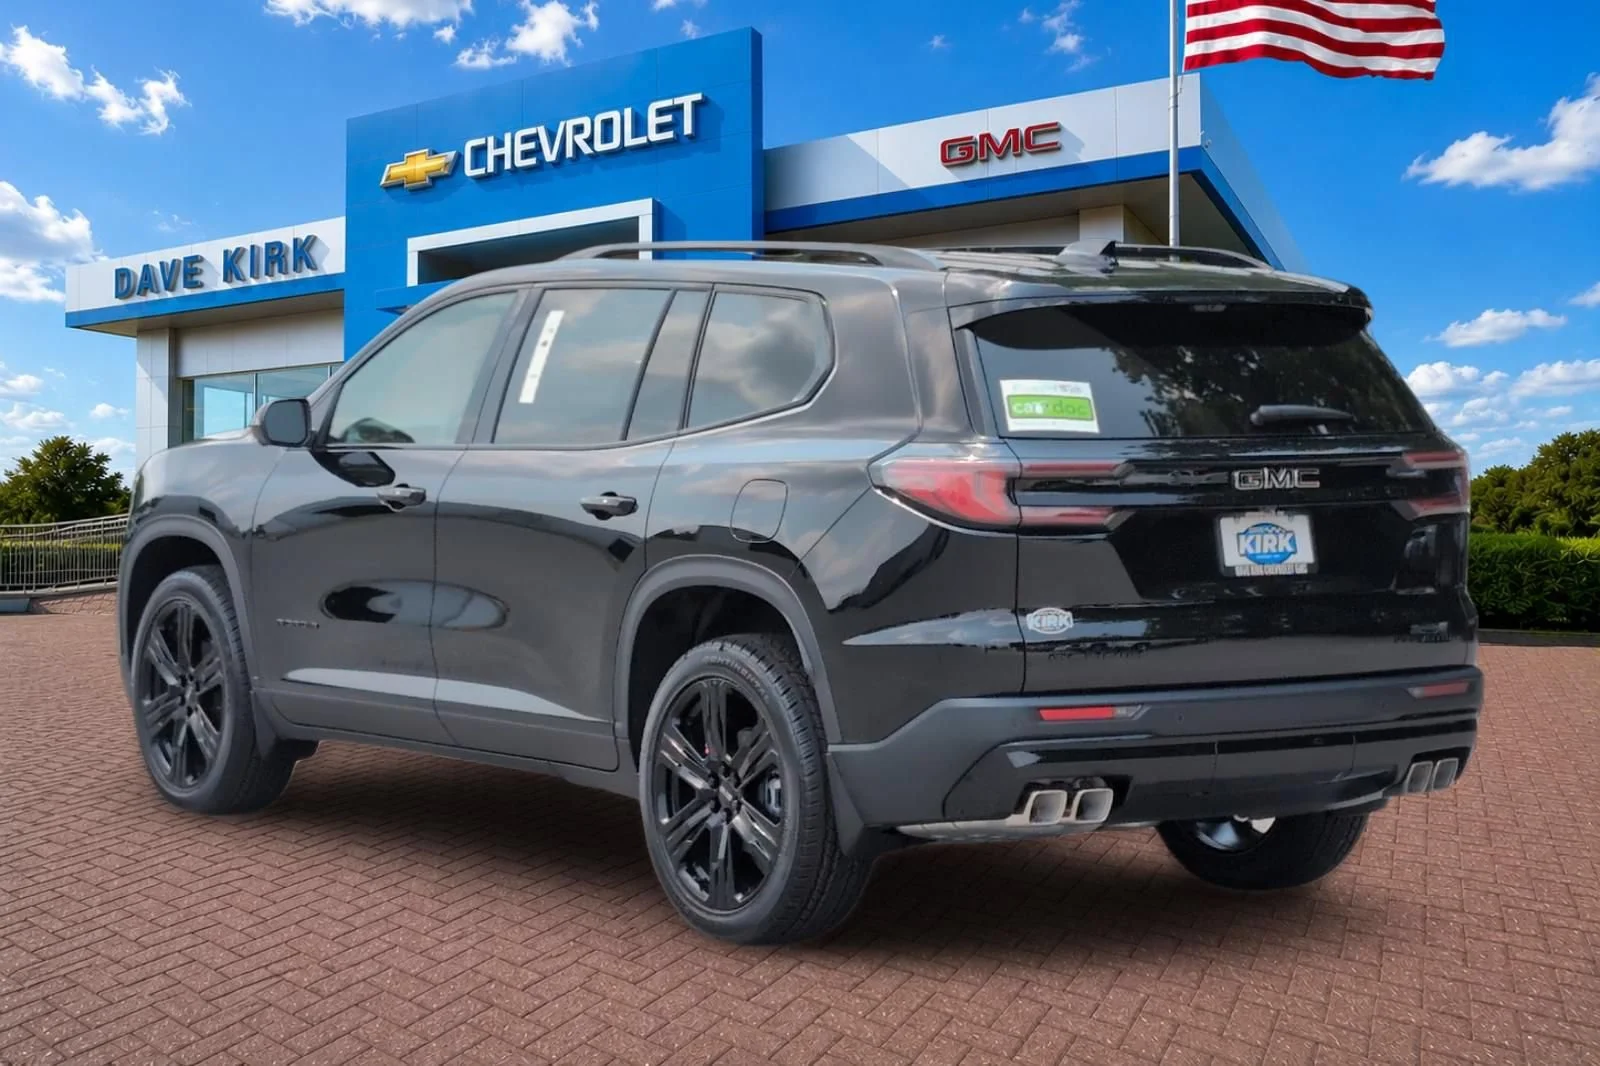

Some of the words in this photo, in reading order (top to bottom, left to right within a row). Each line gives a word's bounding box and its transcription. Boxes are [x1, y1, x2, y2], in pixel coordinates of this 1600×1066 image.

[463, 91, 703, 178] CHEVROLET
[940, 120, 1061, 166] GMC
[114, 254, 204, 300] DAVE
[222, 233, 319, 283] KIRK
[1233, 466, 1321, 491] GMC
[1237, 532, 1297, 556] KIRK
[1026, 611, 1074, 631] KIRK
